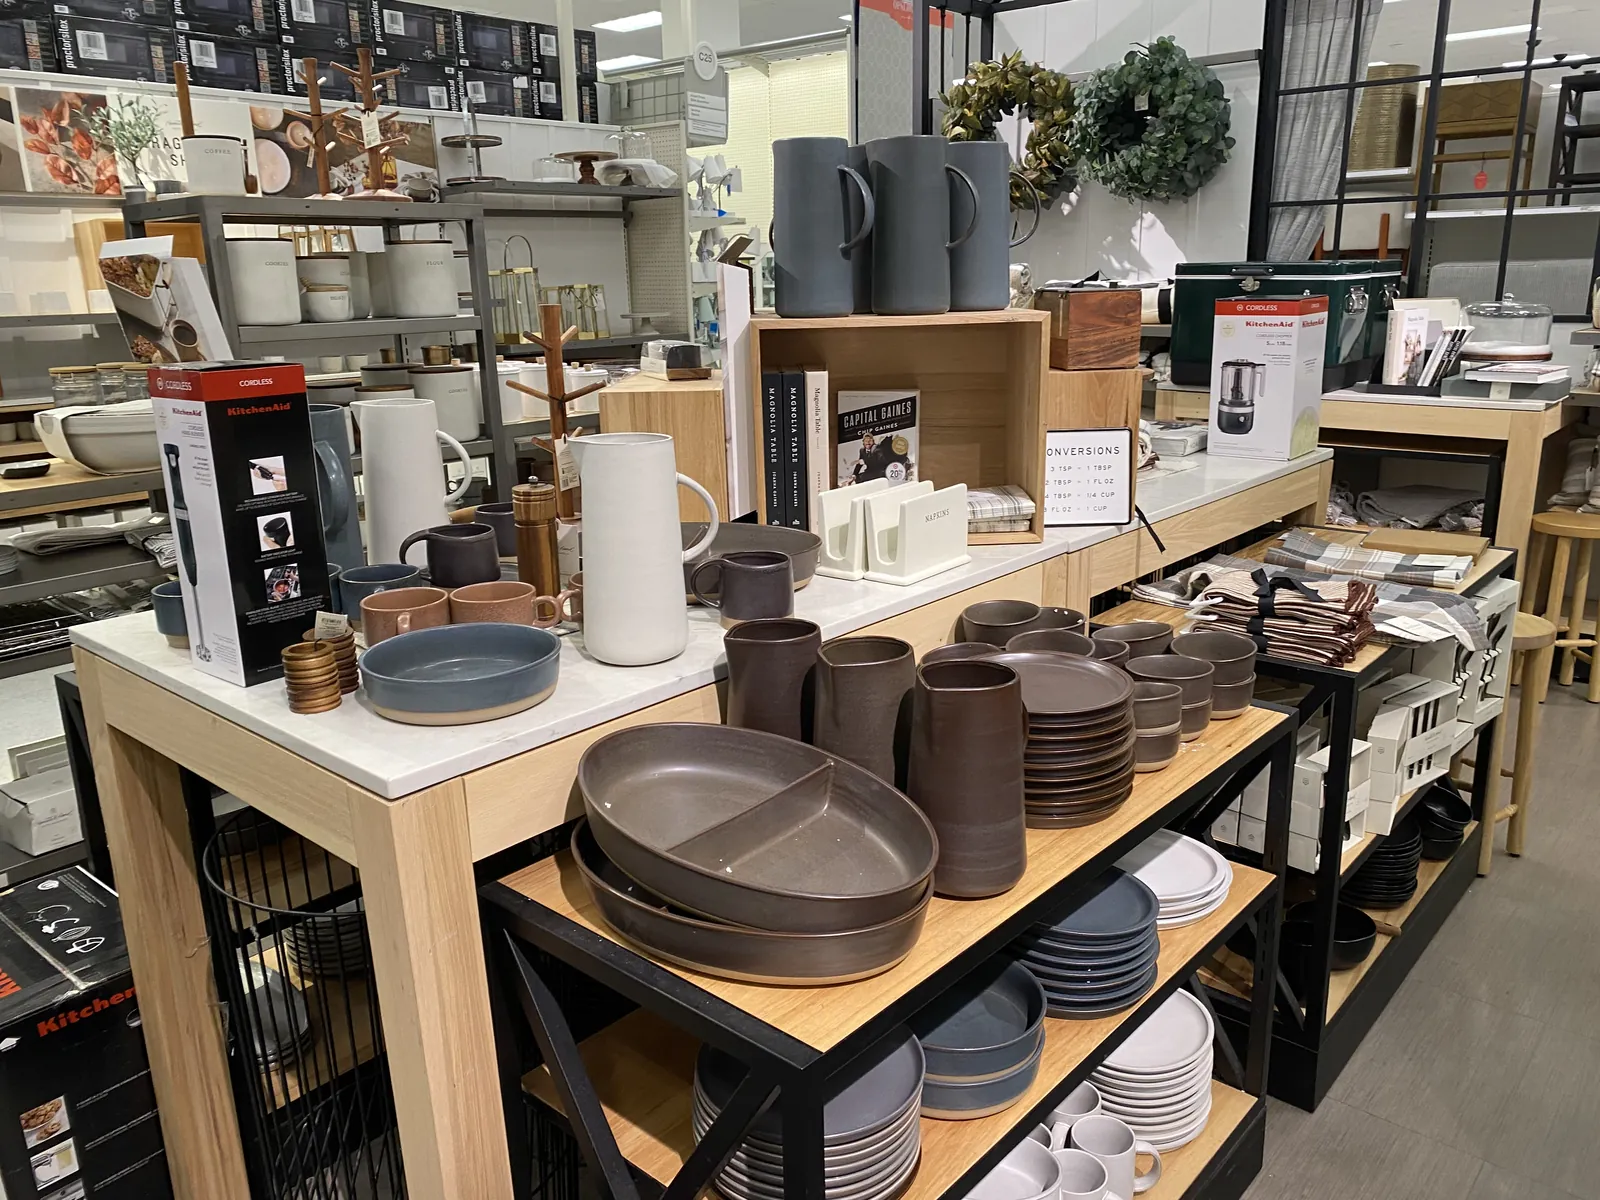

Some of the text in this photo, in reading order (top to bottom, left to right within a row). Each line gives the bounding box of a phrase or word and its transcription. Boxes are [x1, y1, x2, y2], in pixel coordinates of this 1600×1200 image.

[698, 52, 713, 63] C25
[165, 380, 192, 391] CORDLESS
[238, 377, 273, 388] CORDLESS
[172, 407, 203, 417] KitchenAid
[227, 402, 292, 417] KitchenAid
[843, 401, 912, 428] CAPITAL GAINES
[857, 422, 898, 436] CHIP GAINES
[1046, 446, 1120, 457] ONVERSIONS
[924, 508, 950, 523] NAPKINS
[36, 987, 137, 1037] Kitchen
